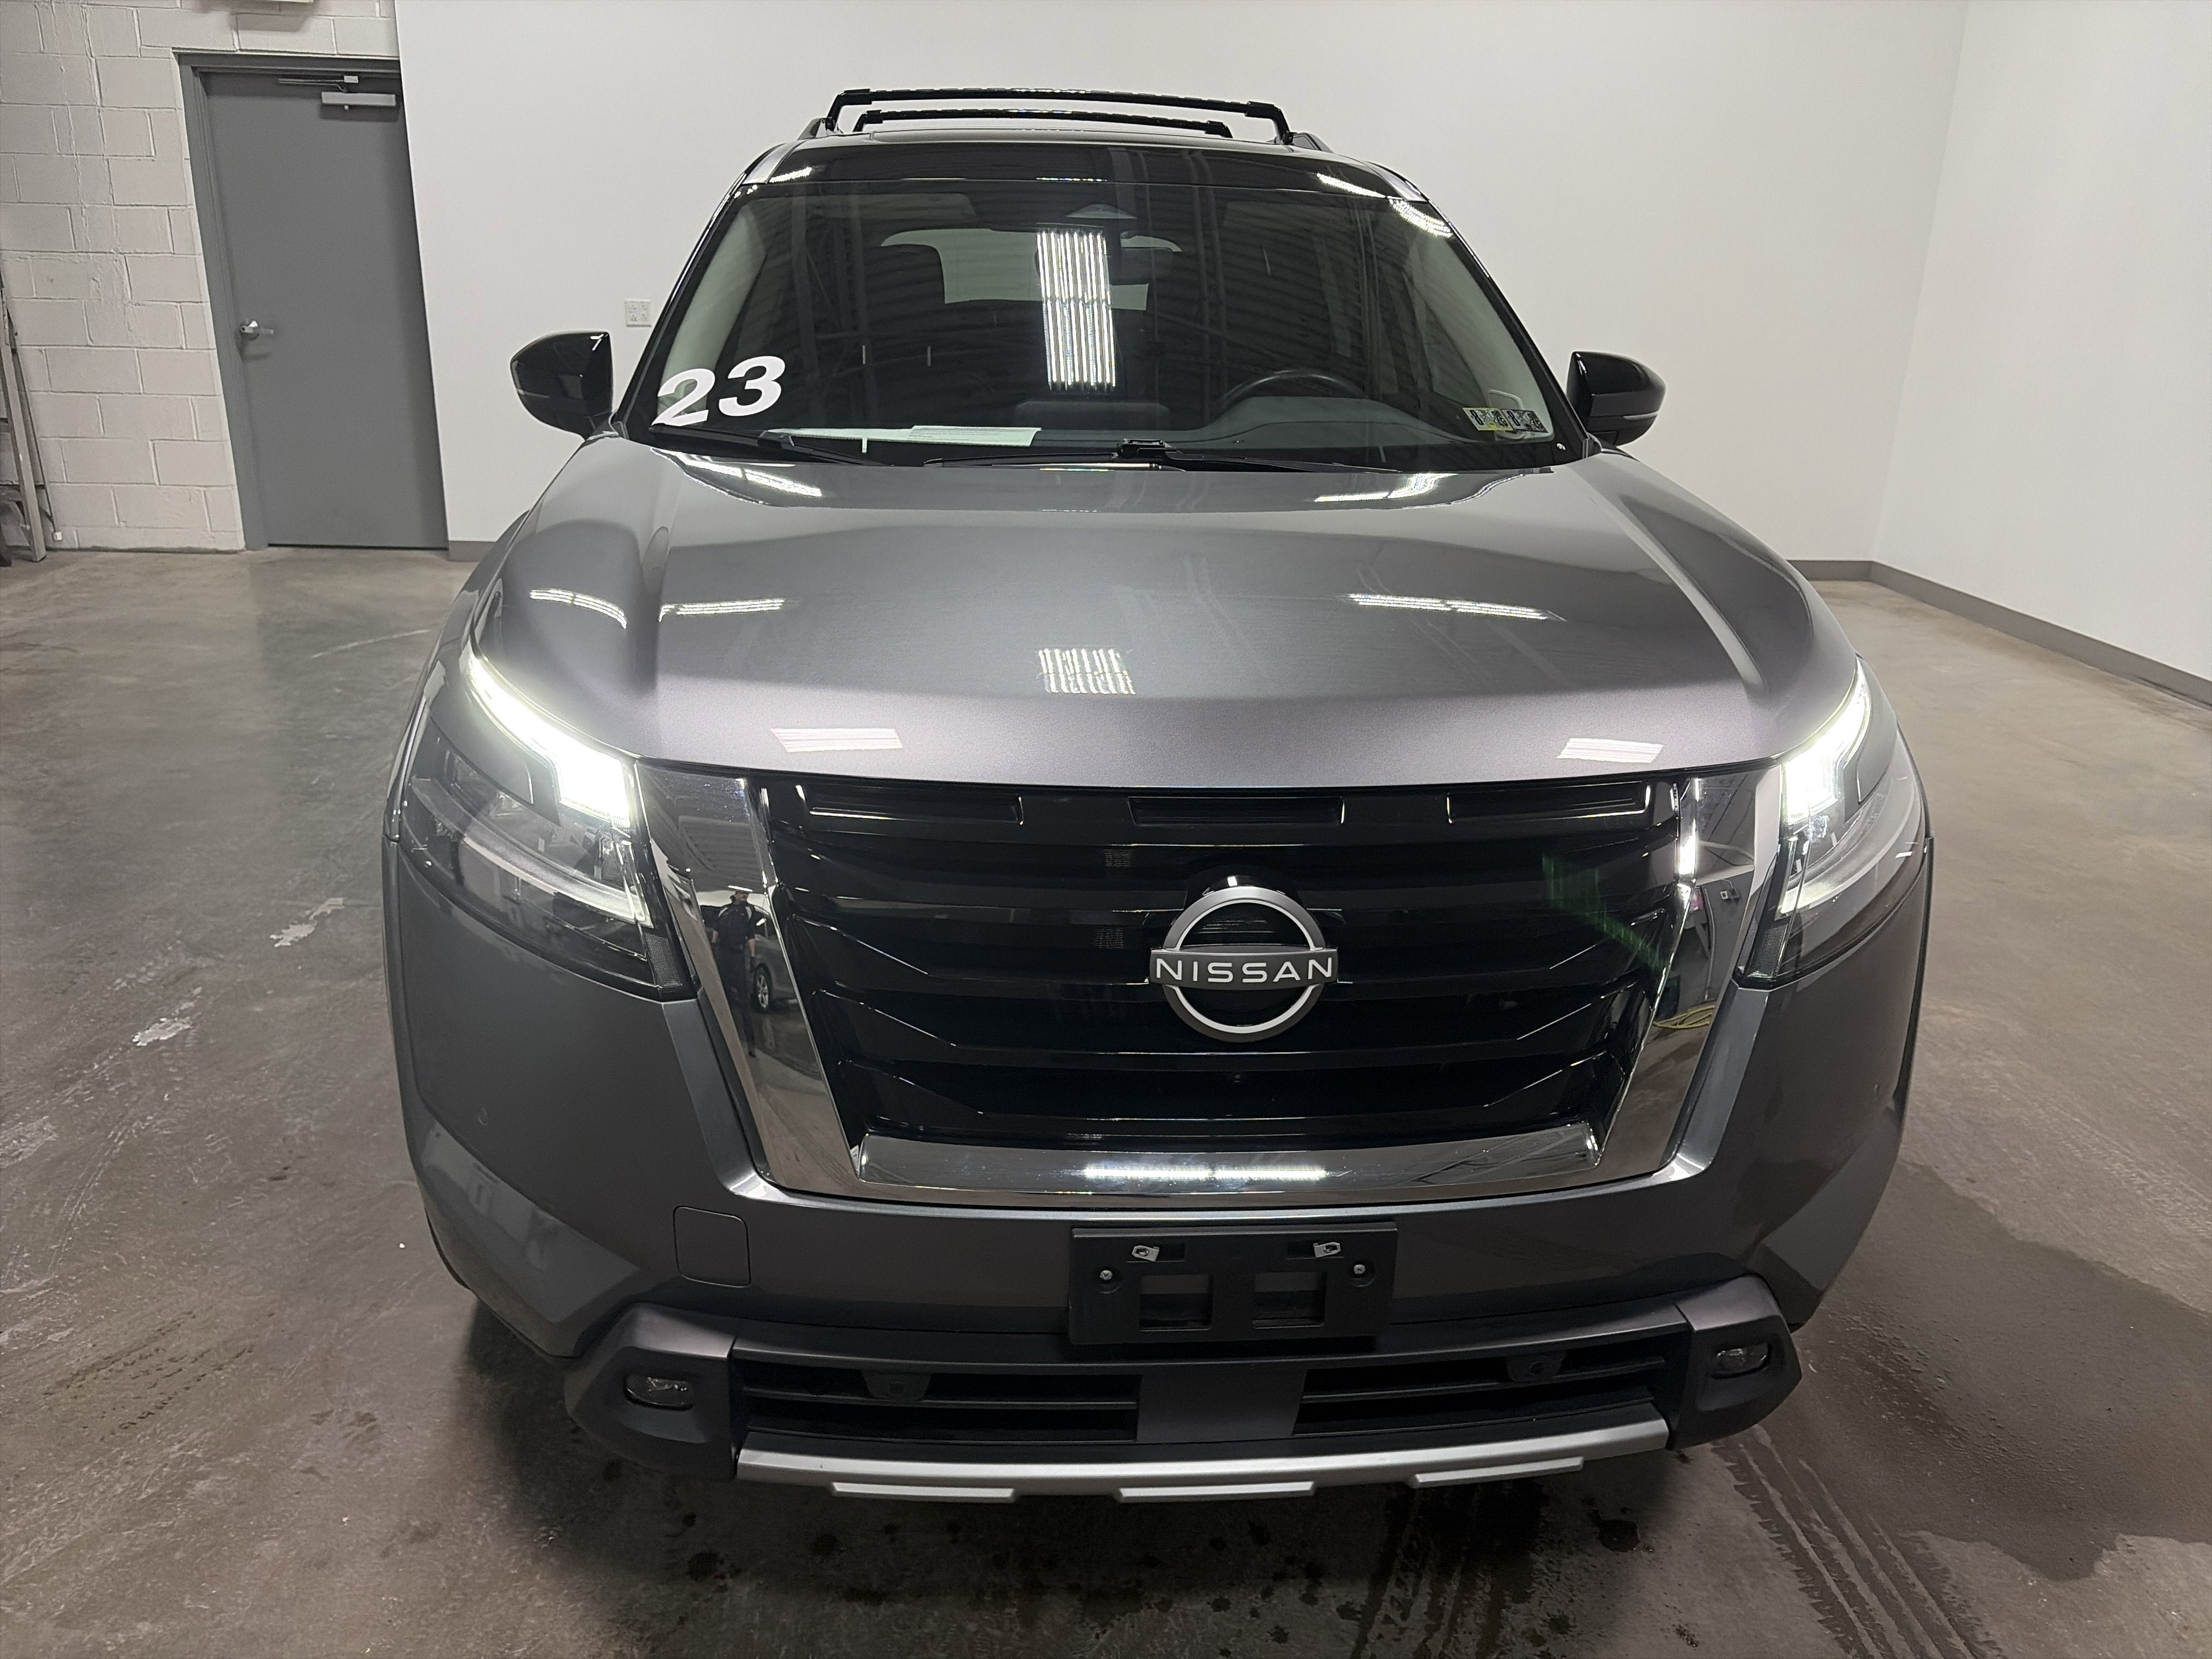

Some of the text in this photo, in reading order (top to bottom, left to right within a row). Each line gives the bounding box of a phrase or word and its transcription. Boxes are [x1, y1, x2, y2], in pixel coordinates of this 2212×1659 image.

[651, 356, 786, 426] 23
[1470, 410, 1484, 425] 8
[1506, 410, 1521, 426] 8
[1156, 957, 1332, 983] NISSAN
